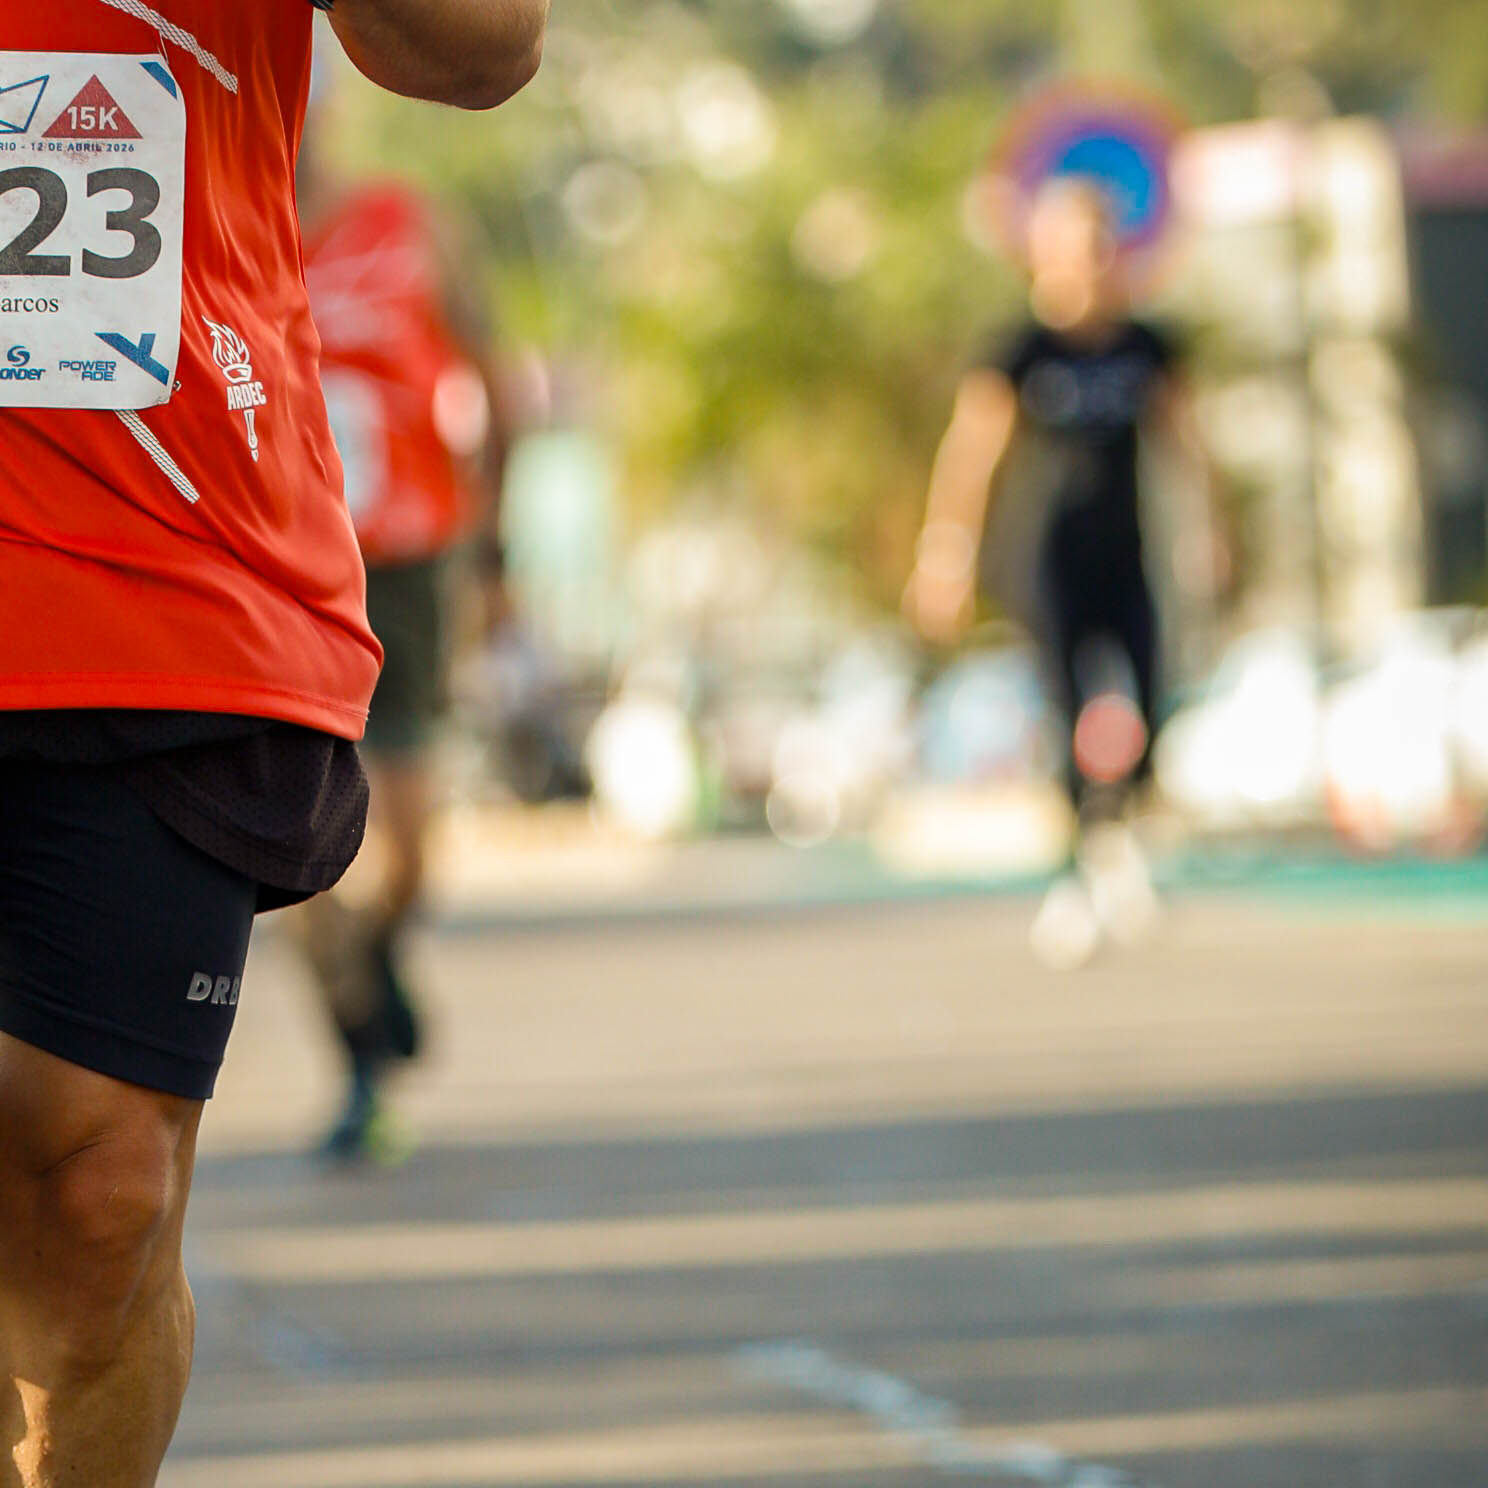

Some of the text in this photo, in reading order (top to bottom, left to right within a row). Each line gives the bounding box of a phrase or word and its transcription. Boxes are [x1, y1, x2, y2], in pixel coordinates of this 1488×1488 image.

[67, 105, 119, 131] 15K
[31, 143, 43, 151] 12
[48, 143, 62, 151] DE
[67, 143, 102, 152] ABRIL
[106, 143, 135, 152] 2026
[58, 360, 117, 371] POWER
[81, 371, 114, 381] ADE
[226, 381, 267, 410] ARDEC
